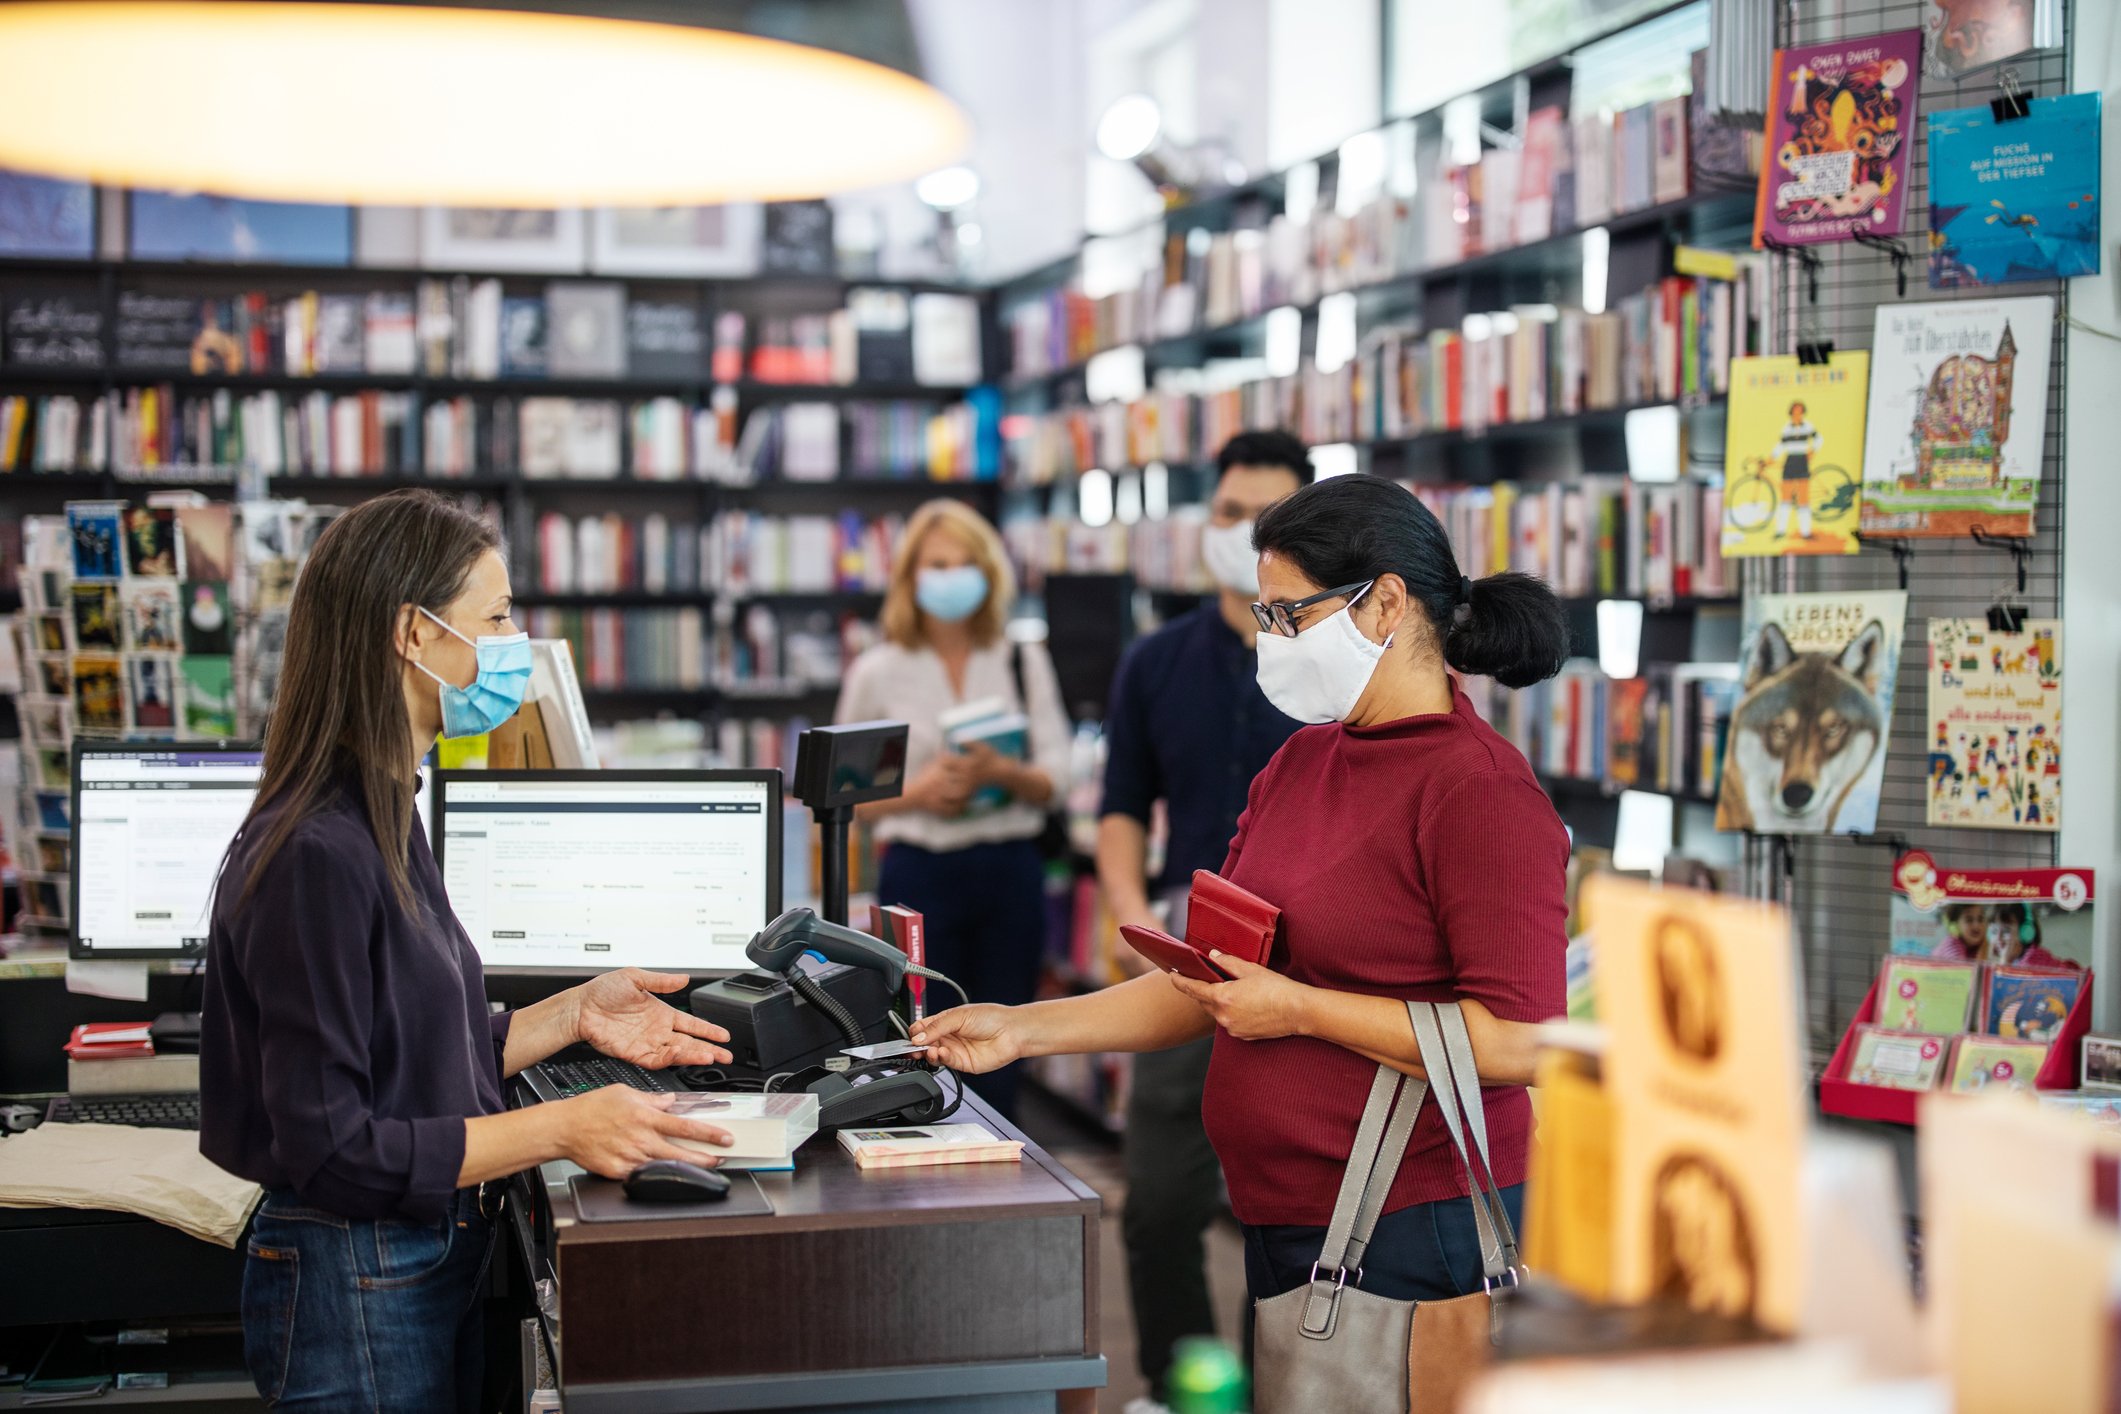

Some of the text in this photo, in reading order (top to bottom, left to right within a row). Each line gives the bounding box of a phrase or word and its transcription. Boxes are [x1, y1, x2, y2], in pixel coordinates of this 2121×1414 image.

[1993, 143, 2030, 156] FUCHS
[1970, 152, 2053, 171] AUF MISSION IN
[1978, 165, 2045, 183] DER TIEFSEE
[1783, 603, 1864, 623] LEBENS
[1942, 671, 1963, 688] Du
[1964, 682, 2016, 699] und ich
[2017, 692, 2045, 708] und
[1948, 704, 2033, 722] alle anderen
[1946, 873, 2041, 897] Ohrwürmchen
